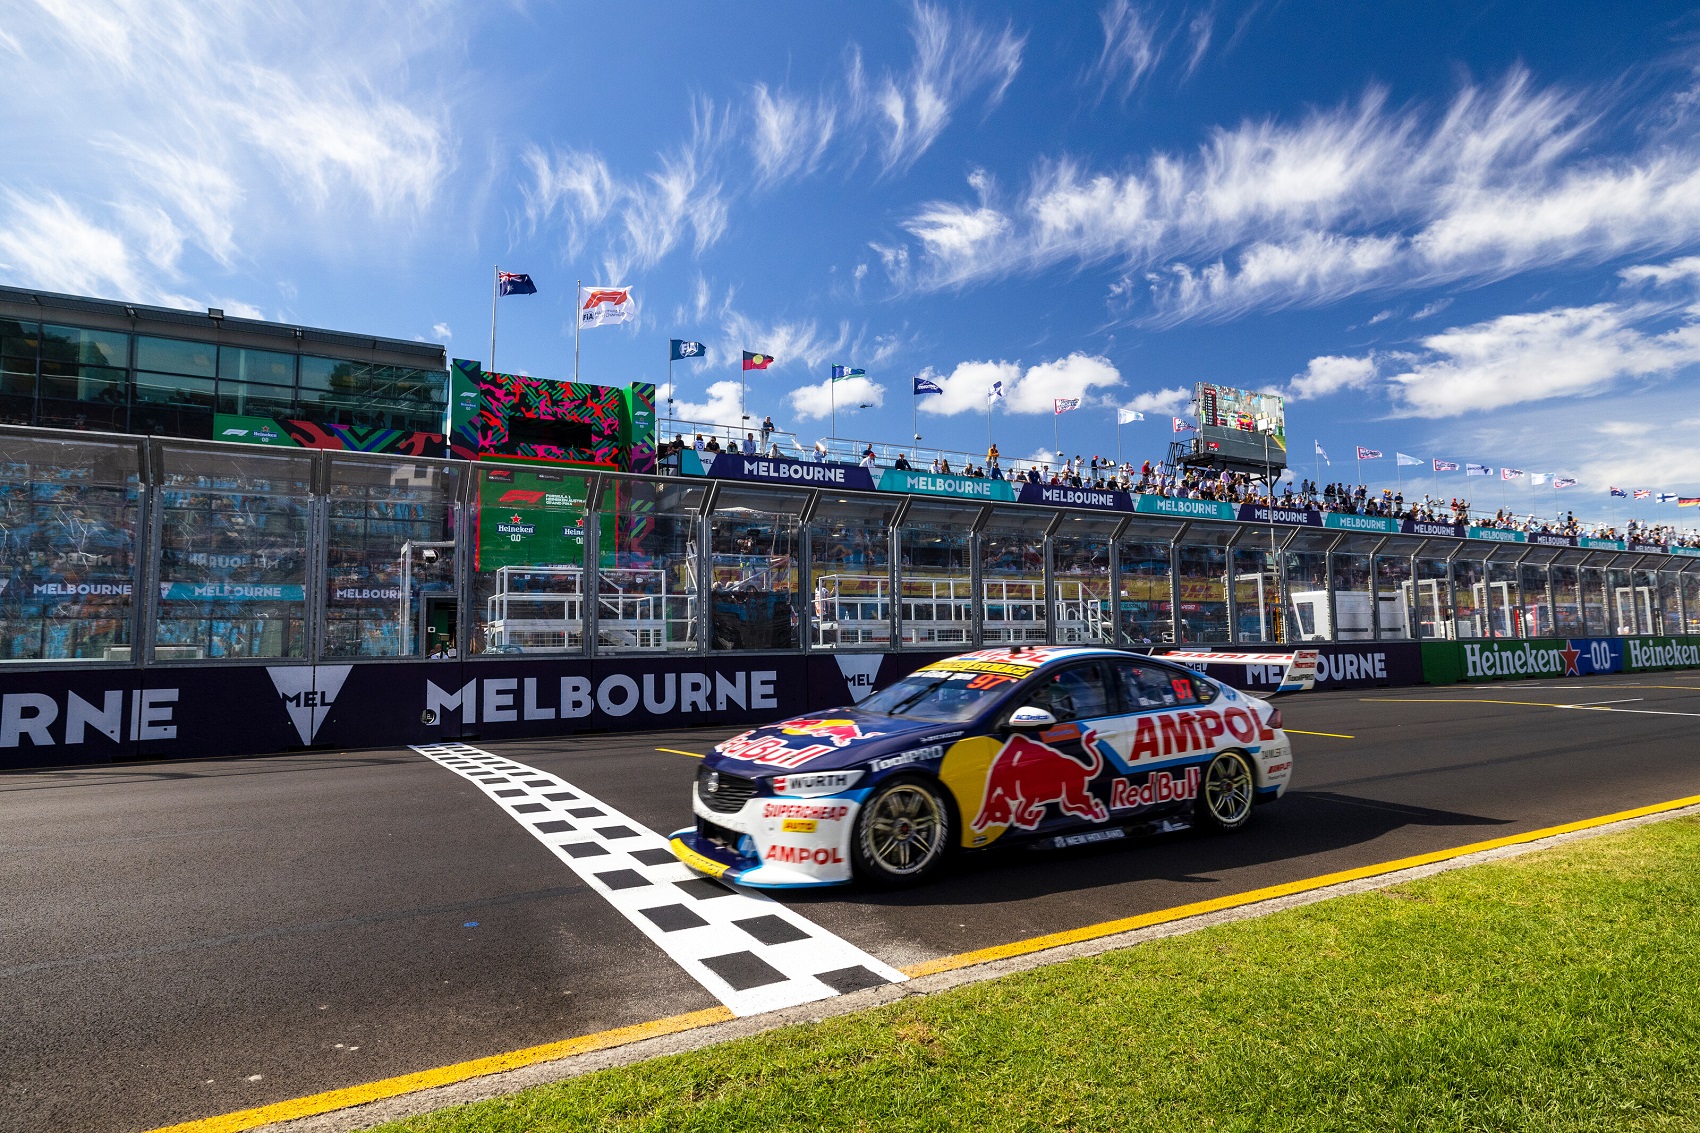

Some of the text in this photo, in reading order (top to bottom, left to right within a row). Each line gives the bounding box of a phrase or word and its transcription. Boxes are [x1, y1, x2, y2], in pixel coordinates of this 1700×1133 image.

[744, 460, 845, 483] MELBOURNE
[907, 475, 991, 495] MELBOURNE
[1042, 488, 1114, 506] MELBOURNE
[1156, 499, 1218, 515] MELBOURNE
[498, 525, 534, 534] Heineken
[1339, 516, 1386, 530] MELBOURNE
[1413, 523, 1455, 537] MELBOURNE
[1480, 530, 1516, 541] MELBOURNE
[1537, 535, 1570, 546] MELBOURNE
[33, 584, 131, 595] MELBOURNE
[1464, 642, 1562, 677] Heineken
[1590, 641, 1611, 670] 0.0
[1628, 639, 1700, 668] Heineken
[844, 673, 875, 687] MEL
[966, 674, 1011, 690] 97
[1171, 679, 1193, 699] 97
[281, 691, 334, 708] MEL
[426, 670, 778, 726] MELBOURNE
[1128, 706, 1275, 761] AMPOL
[868, 745, 944, 772] ToolPRO
[1110, 766, 1200, 809] Red Bull
[763, 803, 849, 821] SUPERCHEAP
[785, 821, 815, 831] AUTO
[766, 844, 844, 866] AMPOL
